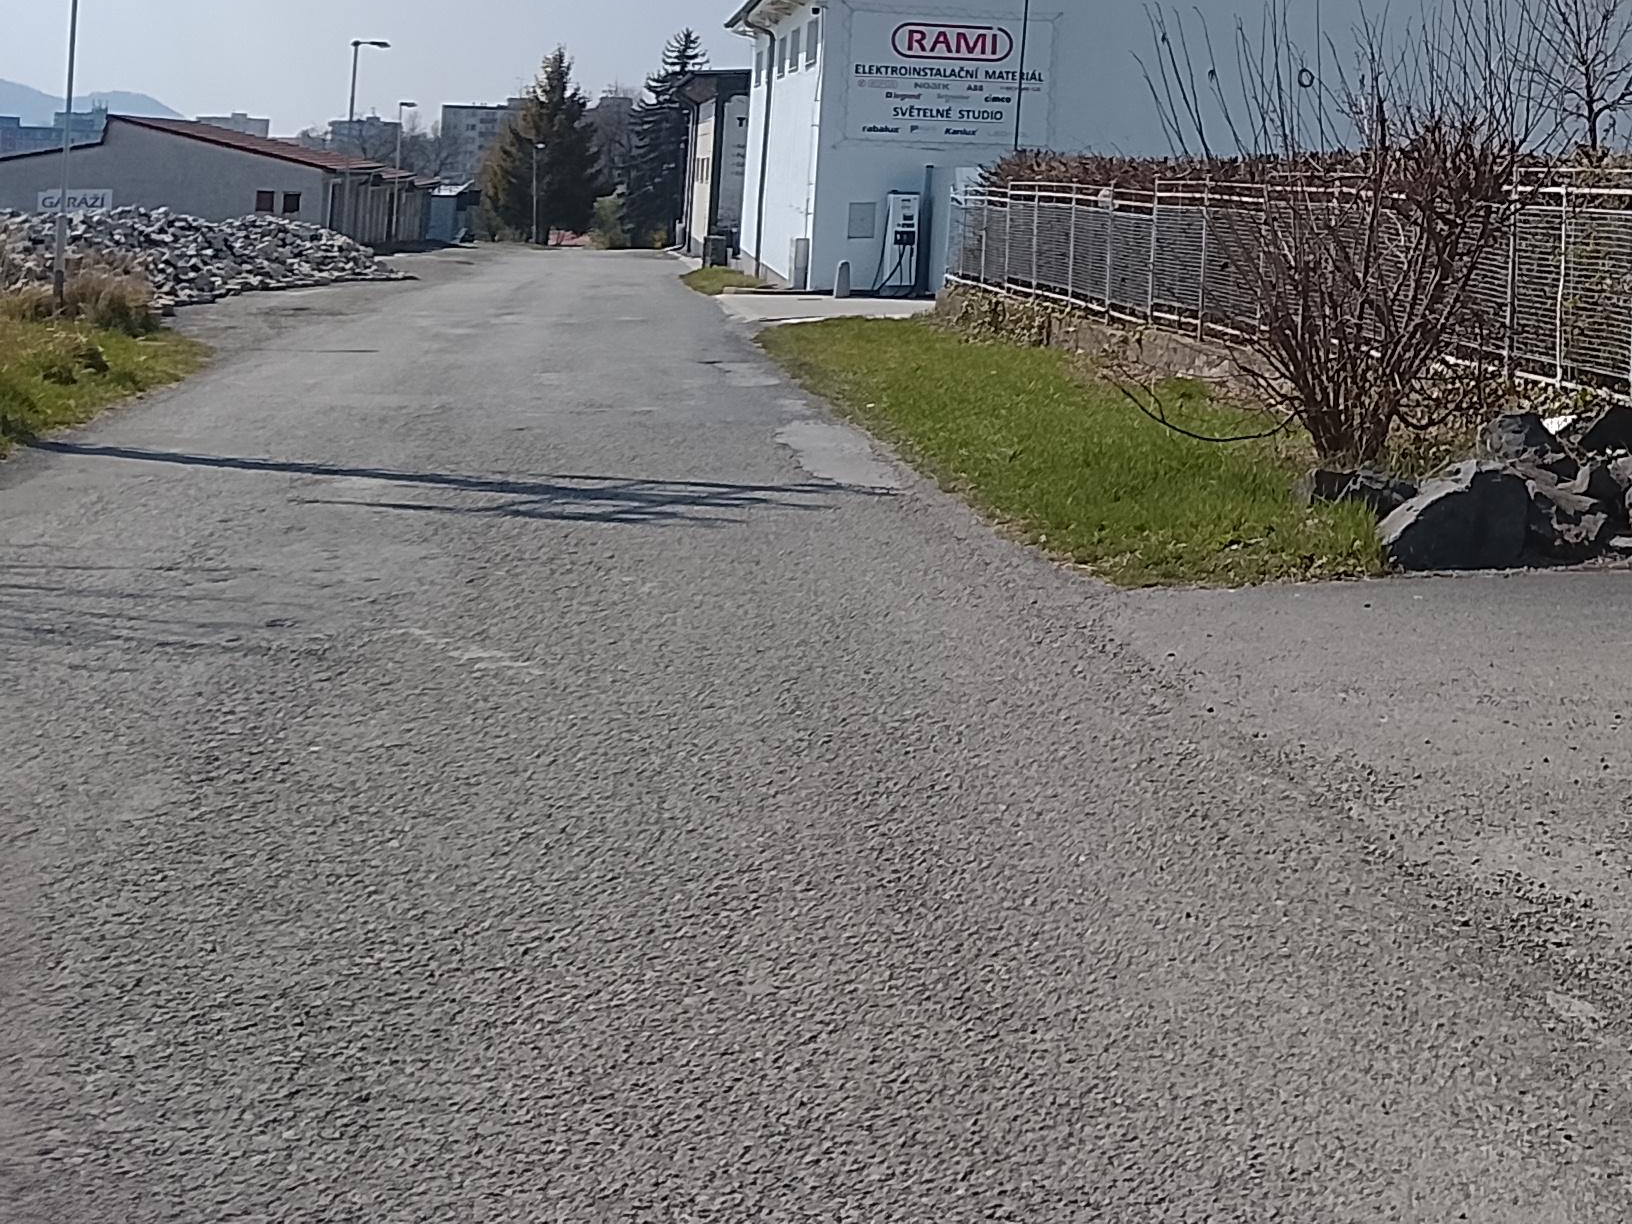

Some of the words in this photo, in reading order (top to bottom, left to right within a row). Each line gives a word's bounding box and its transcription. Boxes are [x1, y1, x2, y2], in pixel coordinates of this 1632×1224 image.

[906, 29, 998, 56] RAMI
[854, 63, 979, 80] ELEKTROINSTALAČNÍ
[984, 69, 1044, 82] MATERIÁL
[892, 105, 952, 119] SVĚTELNÉ
[958, 109, 1003, 120] STUDIO
